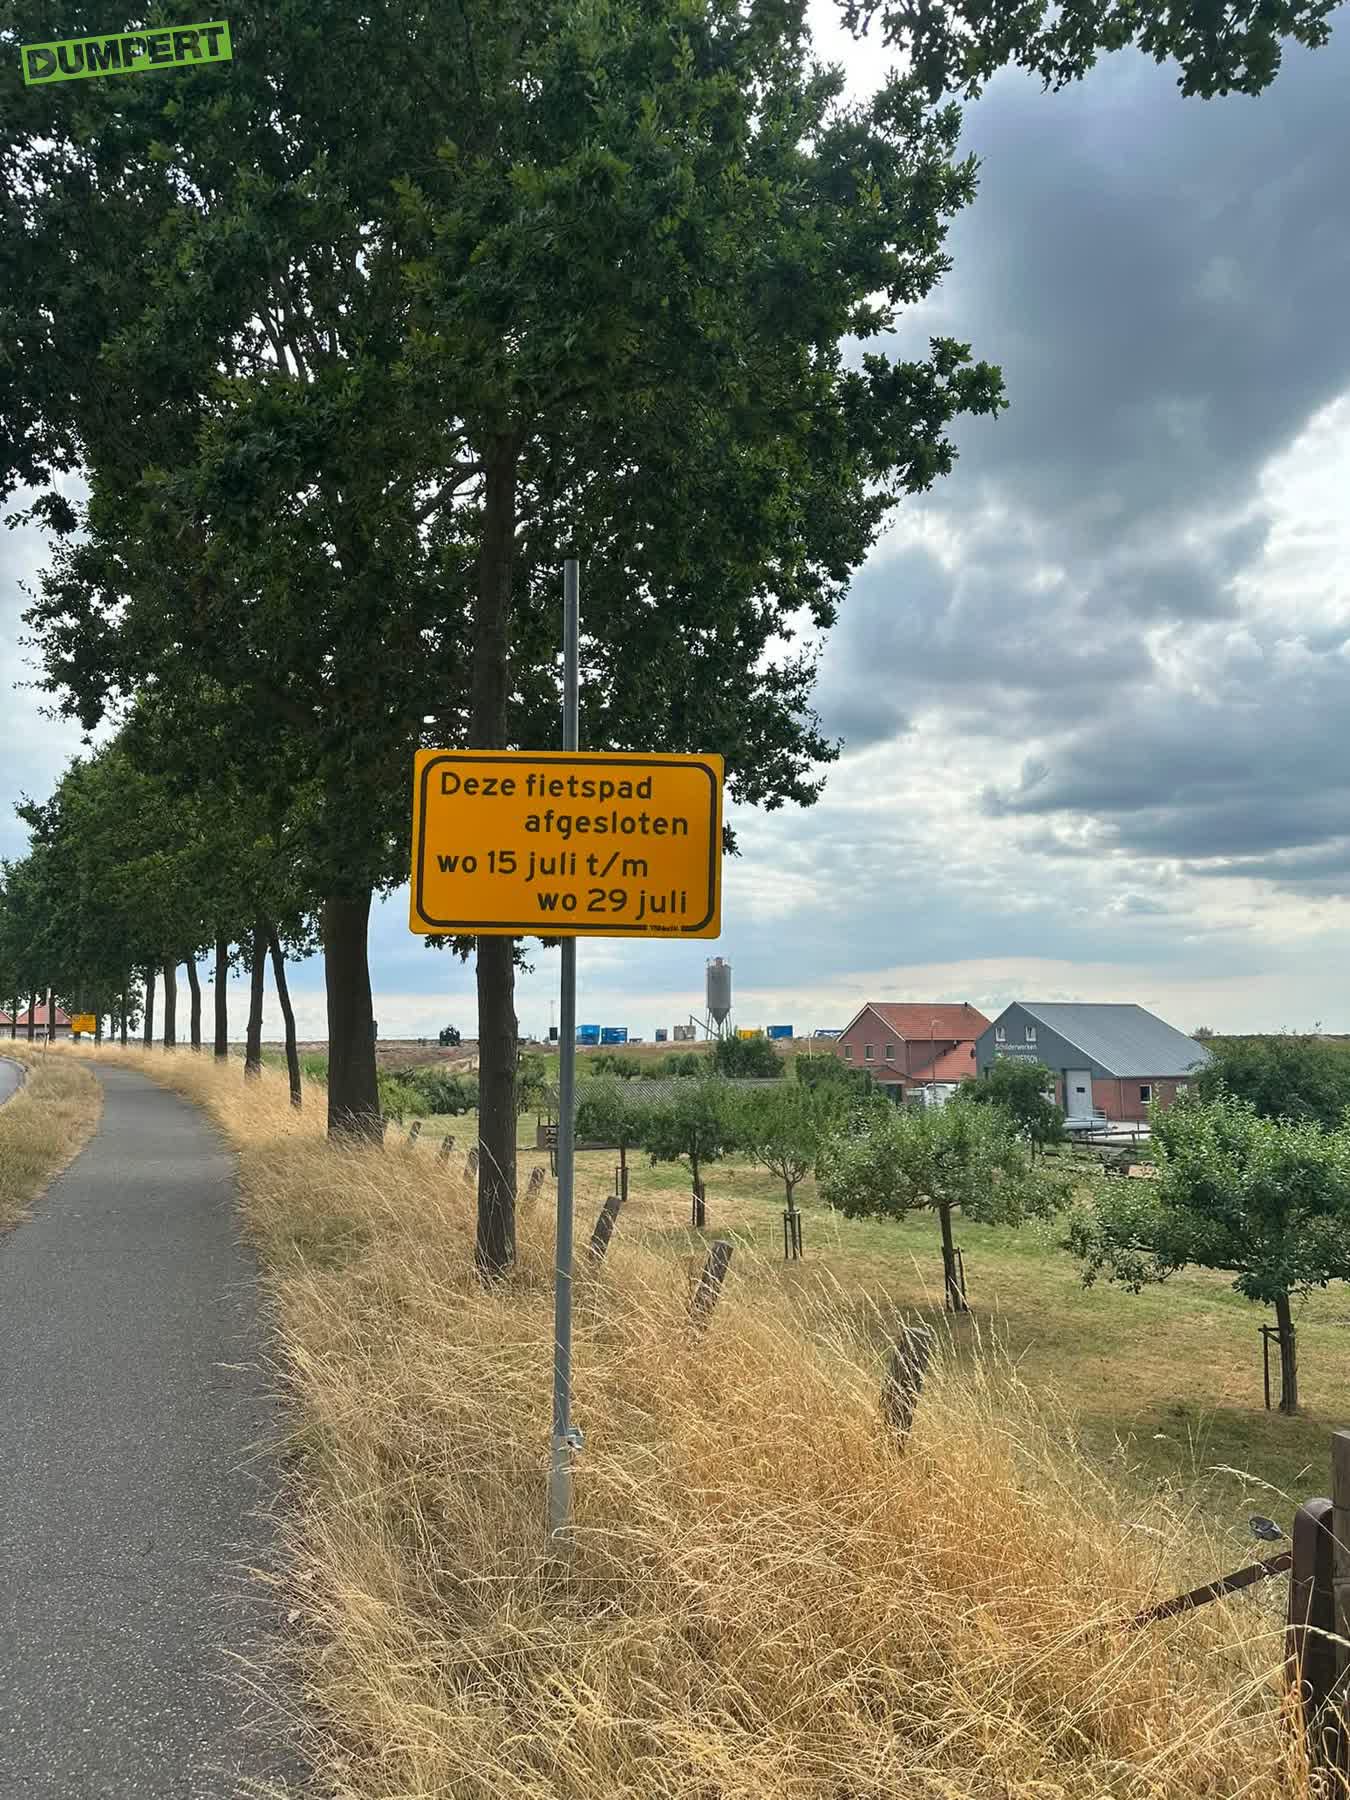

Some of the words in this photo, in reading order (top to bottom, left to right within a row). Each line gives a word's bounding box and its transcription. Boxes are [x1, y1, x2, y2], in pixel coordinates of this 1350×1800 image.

[441, 772, 515, 796] Deze
[526, 774, 652, 802] fietspad
[525, 810, 688, 840] afgesloten
[437, 854, 477, 873] wo
[488, 851, 517, 874] 15
[525, 852, 576, 881] juli
[587, 852, 648, 877] t/m
[538, 892, 577, 912] wo
[587, 888, 627, 912] 29
[636, 890, 687, 920] juli
